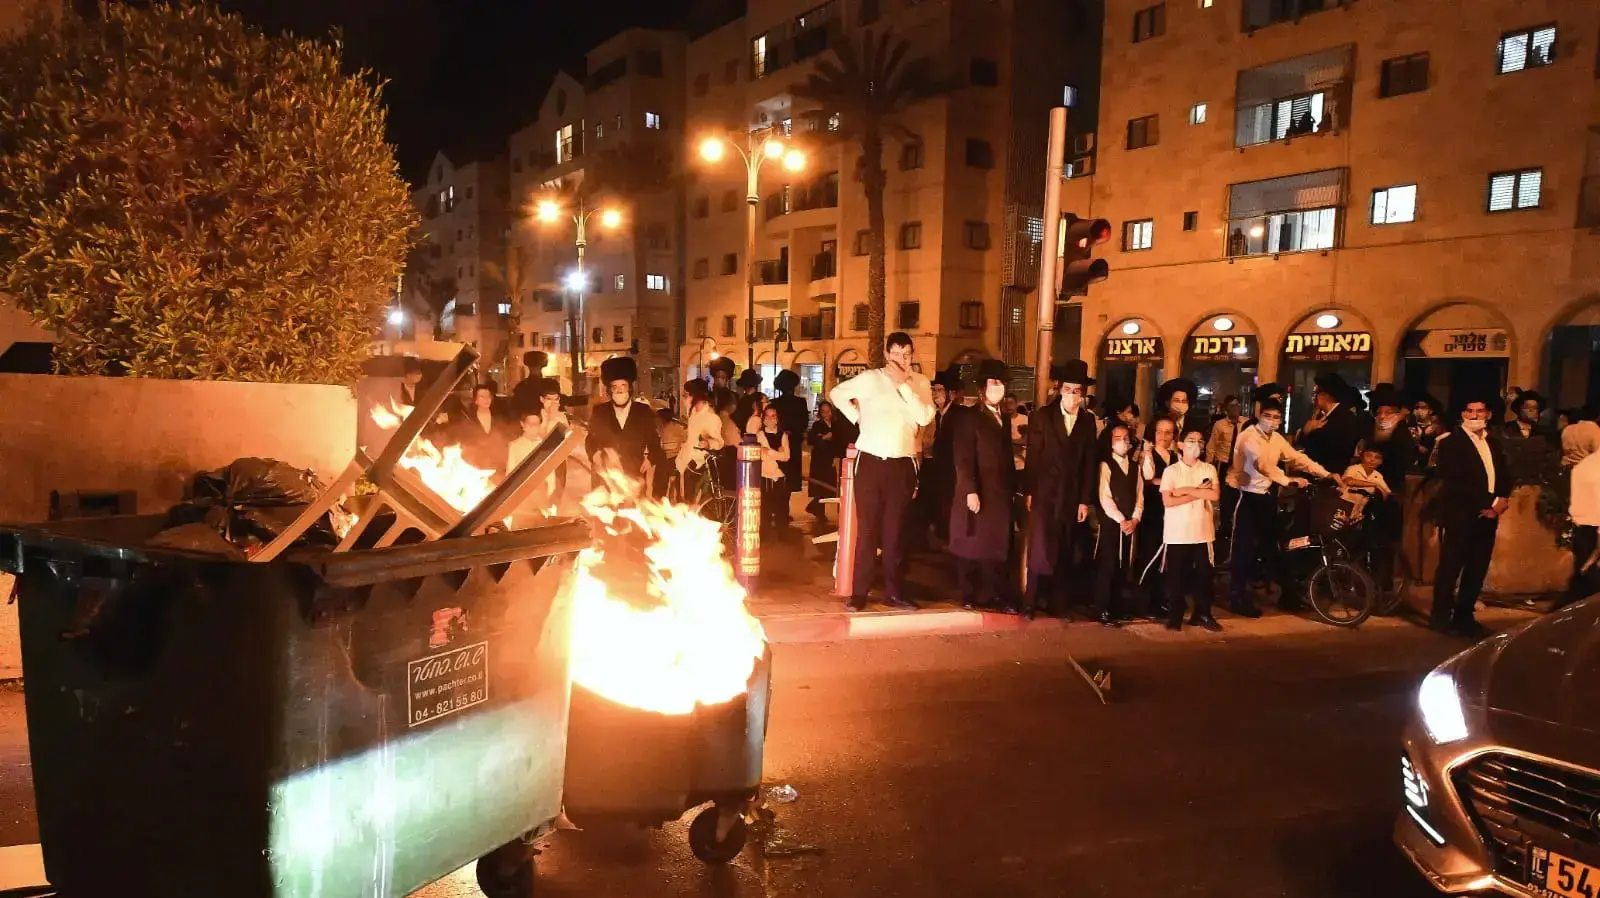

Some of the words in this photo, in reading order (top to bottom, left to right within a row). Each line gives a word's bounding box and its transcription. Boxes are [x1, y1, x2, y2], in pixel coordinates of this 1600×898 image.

[1108, 338, 1157, 355] ארצנו
[1193, 336, 1248, 354] ברכת
[1285, 333, 1371, 353] מאפיית
[414, 671, 483, 700] www.pachter.co.il
[1558, 859, 1600, 898] 54
